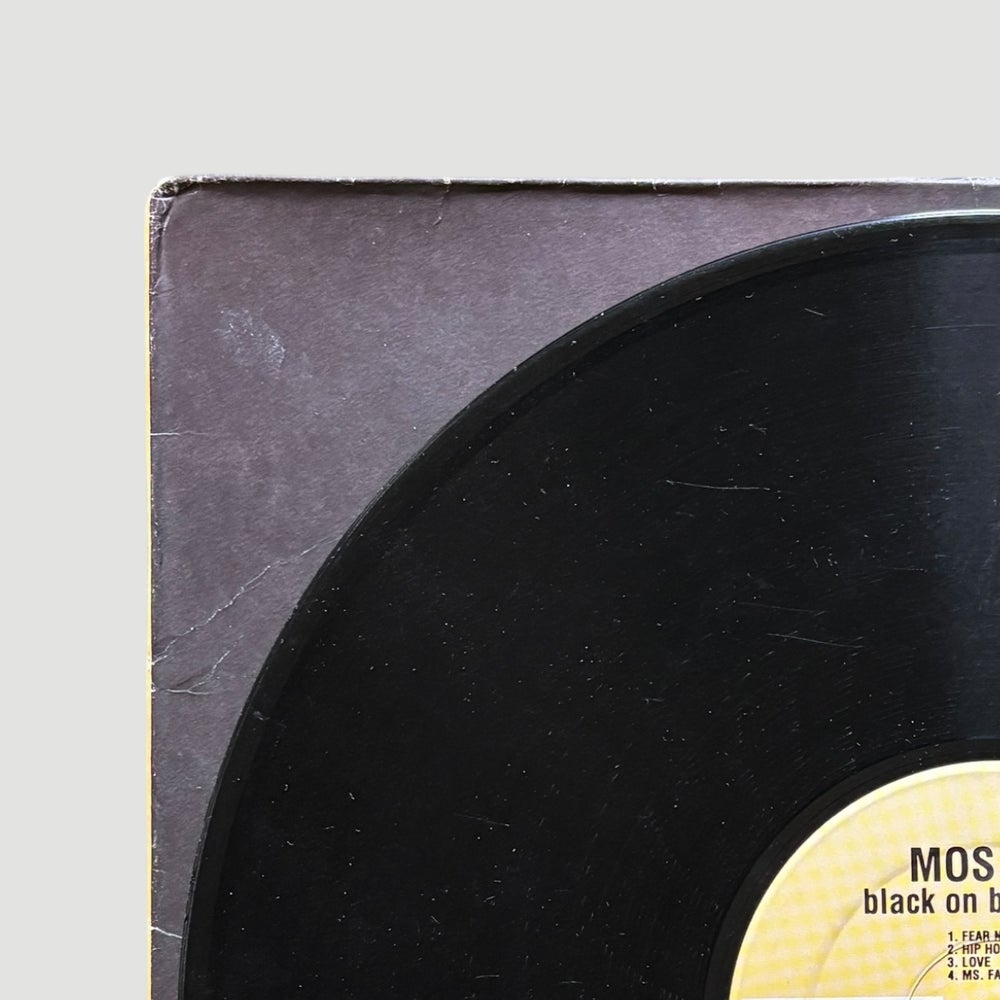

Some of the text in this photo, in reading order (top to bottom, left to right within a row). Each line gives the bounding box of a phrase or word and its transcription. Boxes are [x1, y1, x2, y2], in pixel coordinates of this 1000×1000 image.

[910, 846, 995, 883] MOS
[863, 888, 935, 914] black
[946, 893, 978, 914] on
[948, 931, 958, 942] 1.
[962, 931, 990, 941] FEAR
[947, 944, 958, 955] 2.
[962, 944, 982, 954] HIP
[947, 957, 991, 968] 3. LOVE
[947, 970, 958, 980] 4.
[962, 970, 983, 980] MS.
